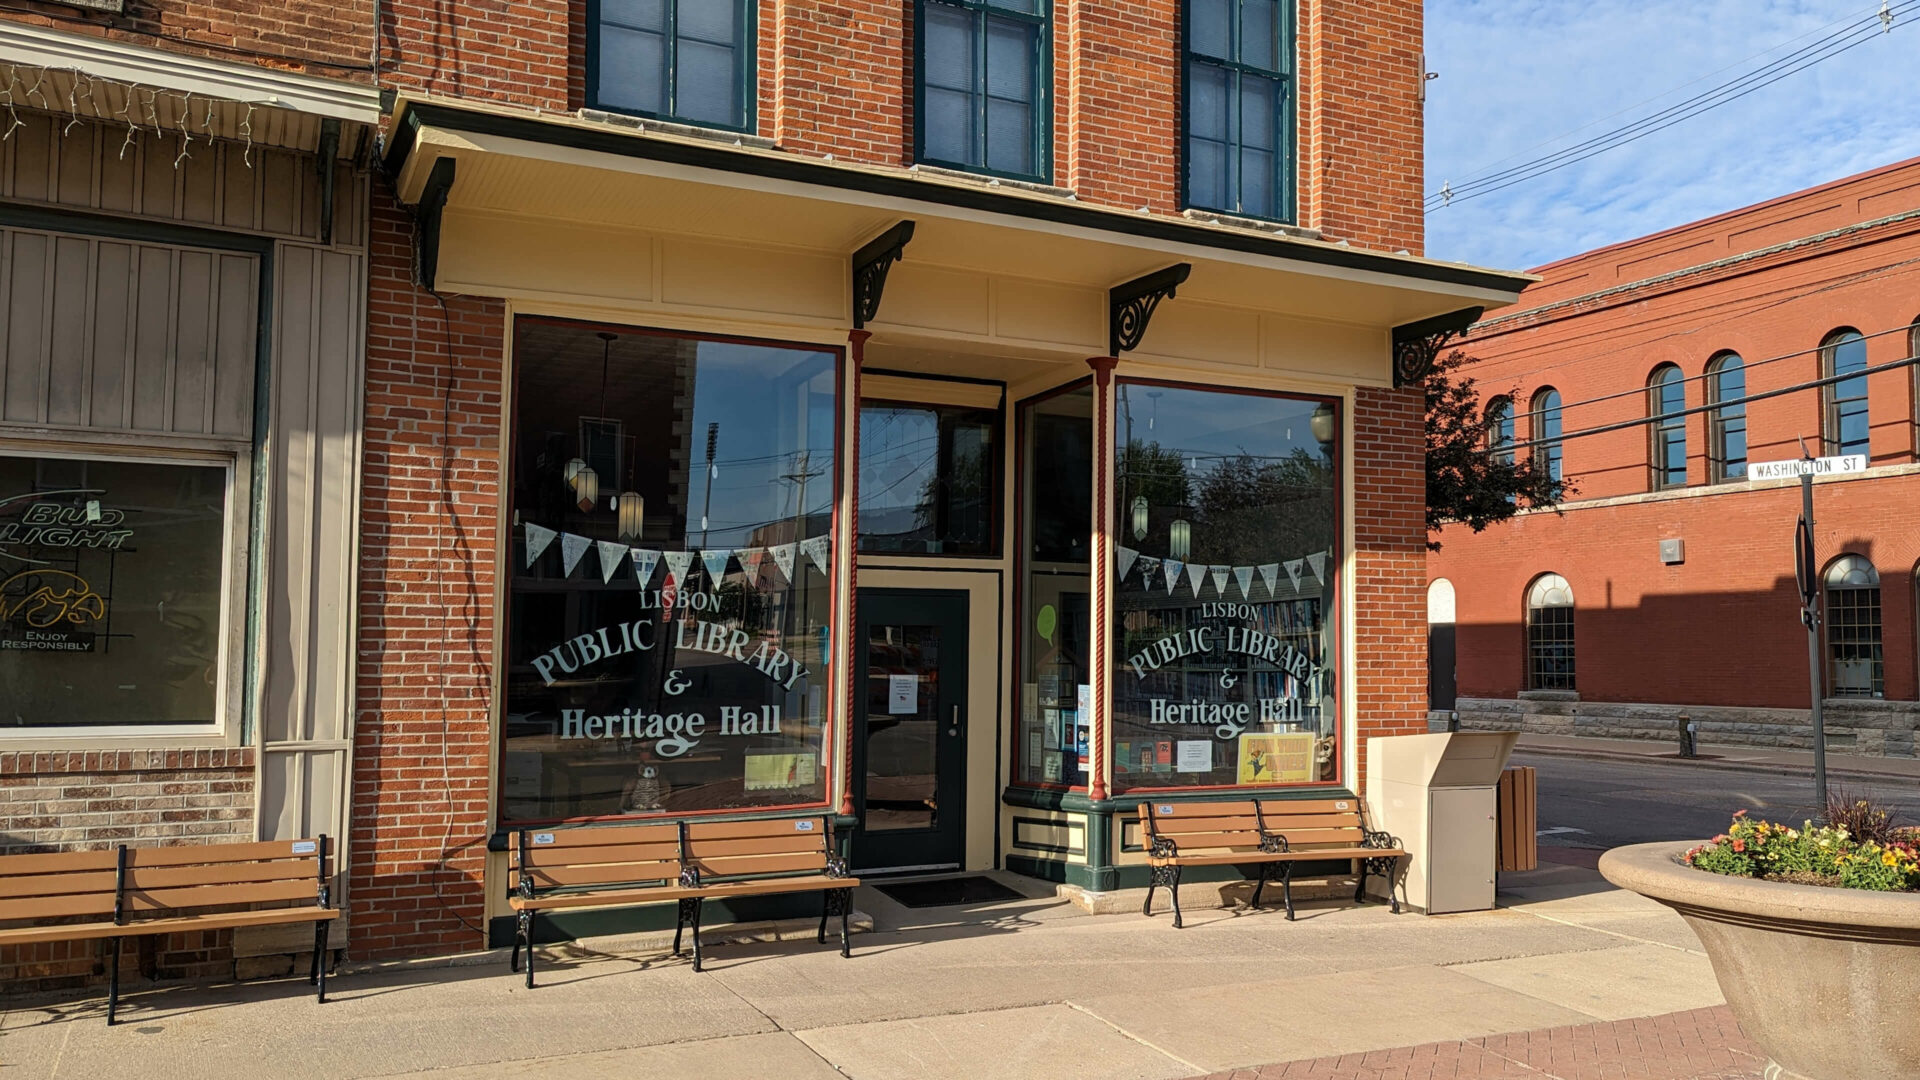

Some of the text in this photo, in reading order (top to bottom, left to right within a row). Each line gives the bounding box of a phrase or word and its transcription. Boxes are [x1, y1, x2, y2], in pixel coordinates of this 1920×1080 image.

[1756, 457, 1857, 477] WASHINGTON ST
[22, 503, 124, 527] BUD
[0, 523, 134, 549] LIGHT
[639, 589, 723, 614] LISBON
[1202, 602, 1260, 622] LISBON
[530, 618, 810, 692] PUBLIC LIBRARY
[1128, 626, 1321, 687] PUBLIC LIBRARY
[664, 669, 692, 695] &
[1219, 668, 1238, 689] &
[560, 705, 781, 757] Heritage Hall
[1150, 698, 1304, 740] Heritage Hall
